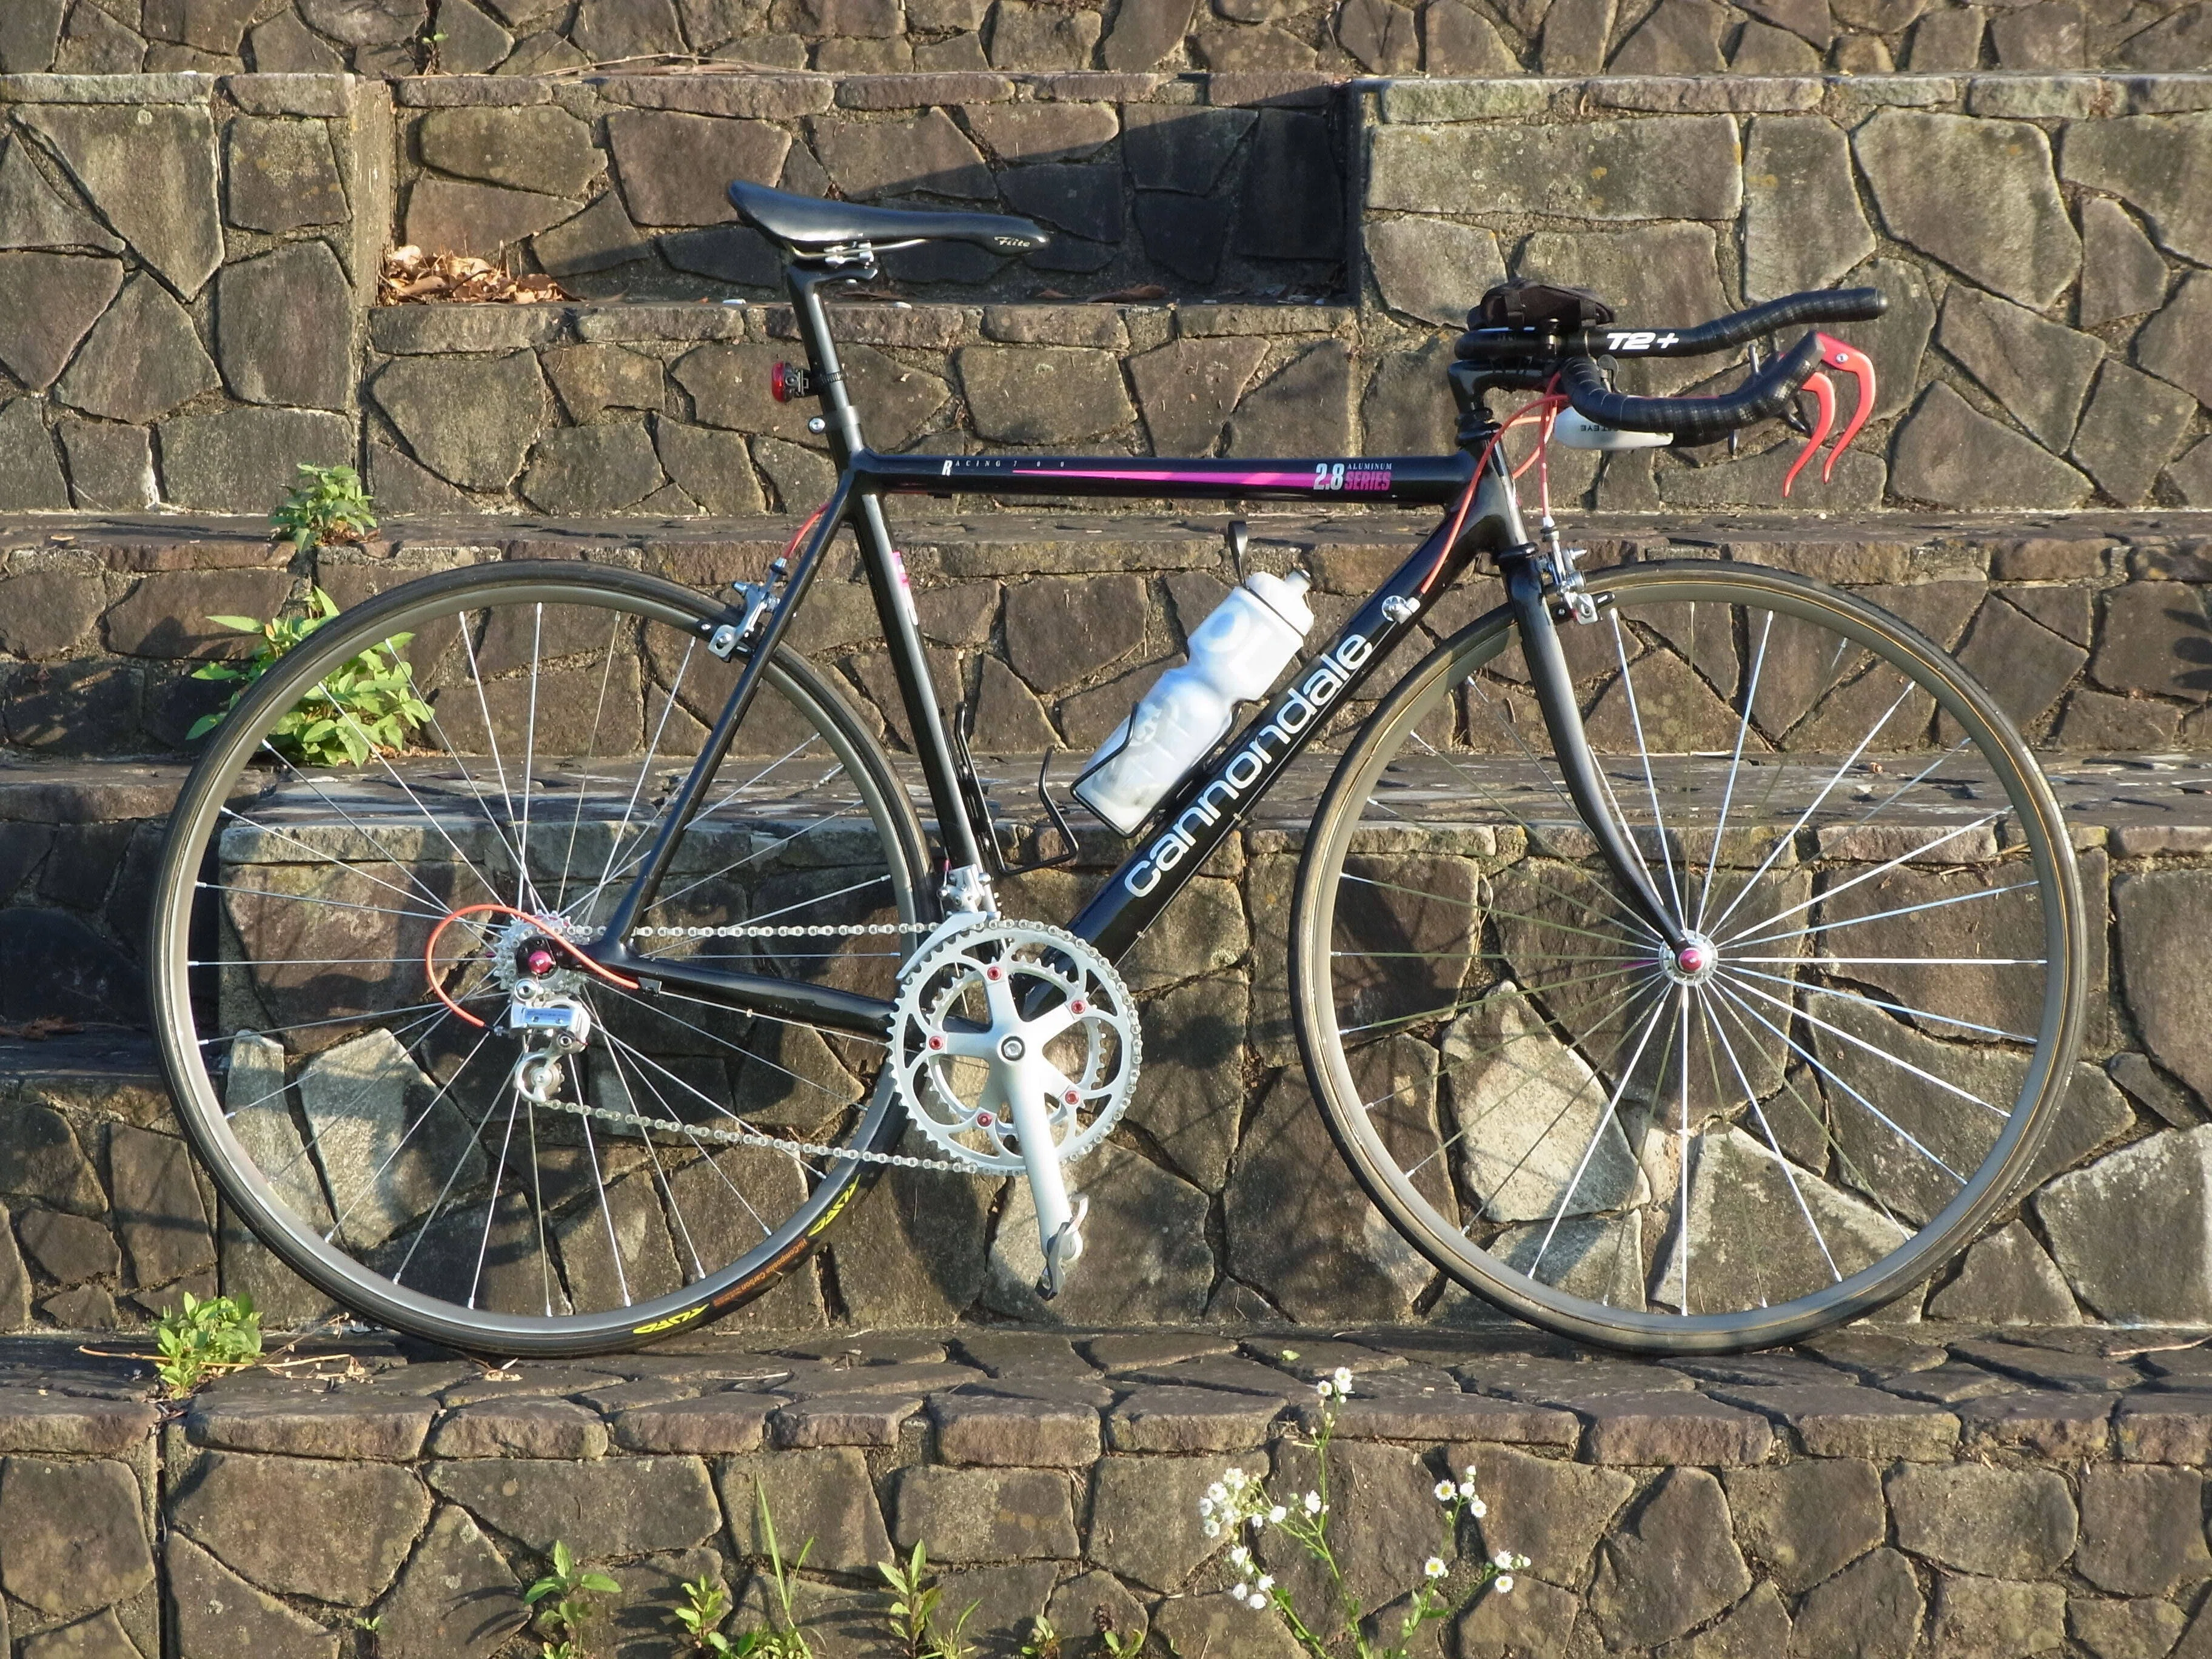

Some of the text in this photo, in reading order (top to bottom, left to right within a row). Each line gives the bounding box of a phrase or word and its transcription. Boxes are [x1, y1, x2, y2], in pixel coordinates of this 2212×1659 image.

[1606, 332, 1680, 350] T2+
[942, 460, 1001, 476] RACING
[1313, 463, 1345, 491] 2.8
[1344, 471, 1392, 491] SERIES
[1124, 634, 1373, 898] cannondale
[741, 1272, 766, 1290] Carbon
